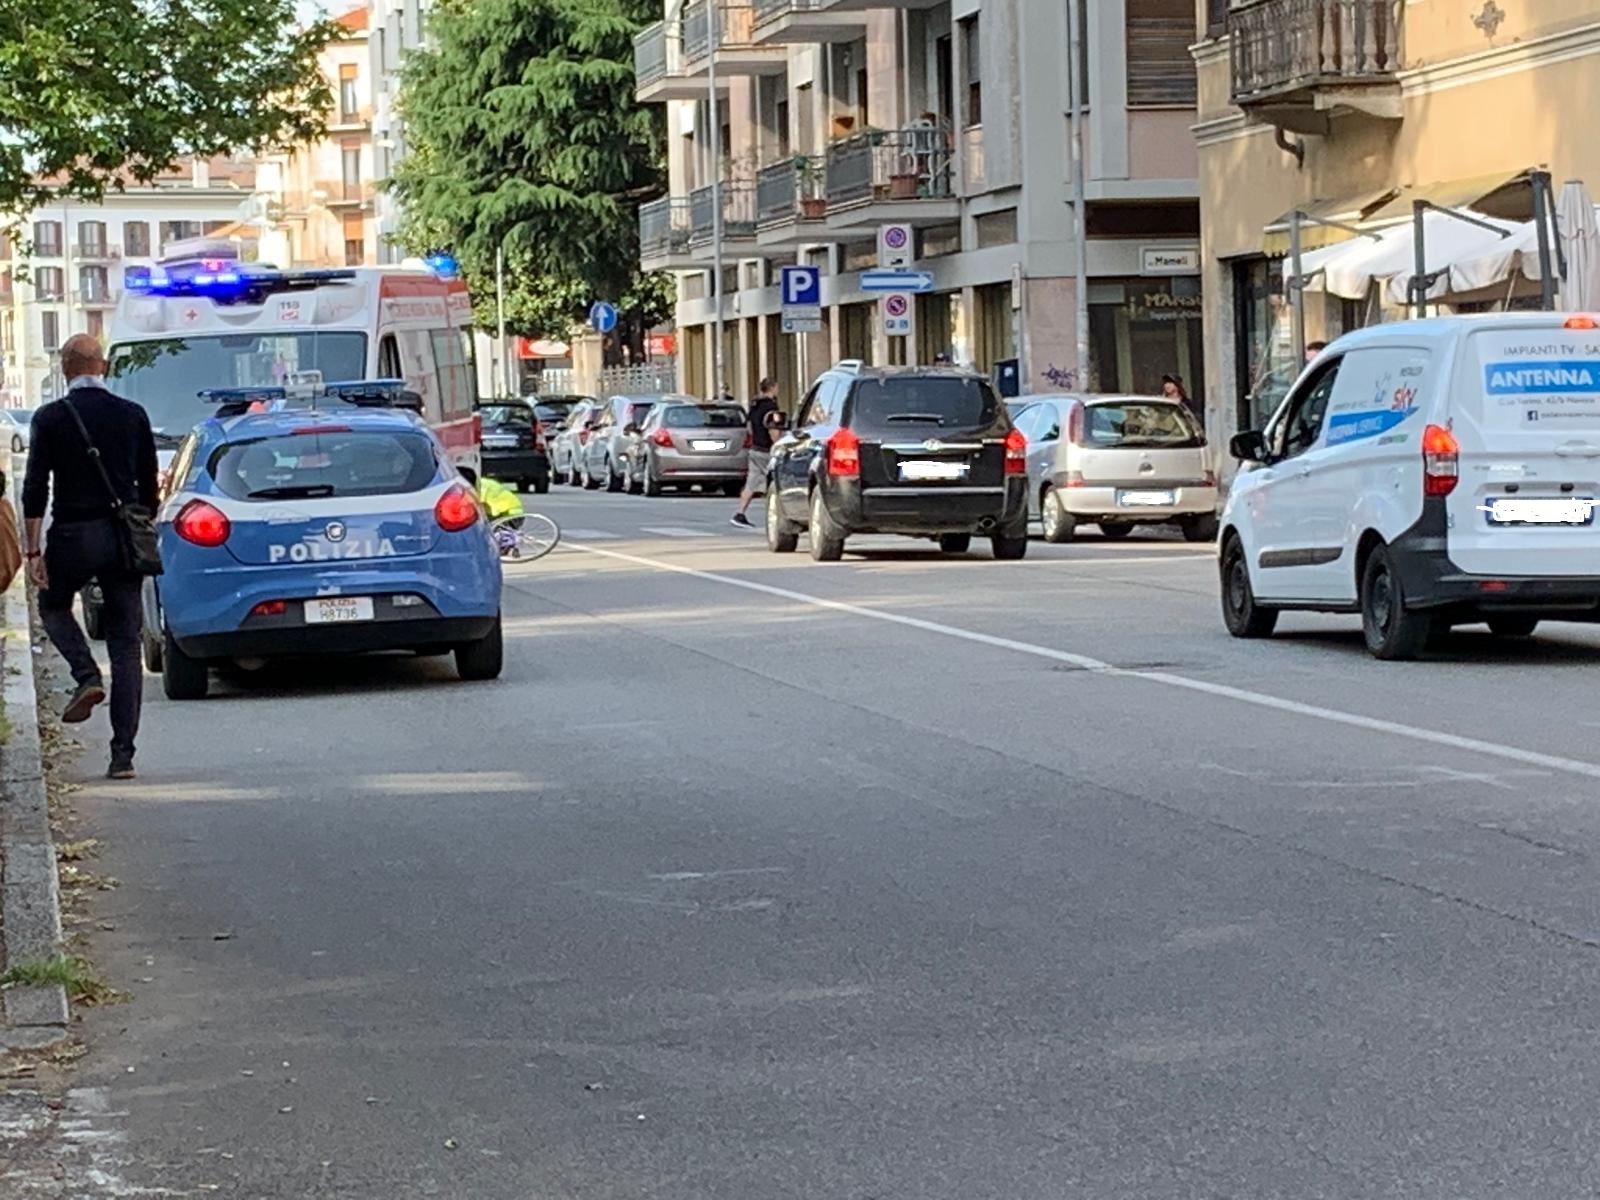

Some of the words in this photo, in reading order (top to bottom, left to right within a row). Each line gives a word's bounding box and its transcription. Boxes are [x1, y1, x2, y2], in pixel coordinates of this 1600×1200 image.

[1155, 256, 1188, 266] Mameli
[789, 270, 813, 302] P
[1503, 345, 1557, 356] IMPIANTI
[1561, 344, 1575, 355] TV
[1491, 369, 1593, 388] ANTENNA
[269, 538, 396, 563] POLIZIA
[319, 599, 357, 608] POLIZIA
[321, 608, 358, 621] H8736
